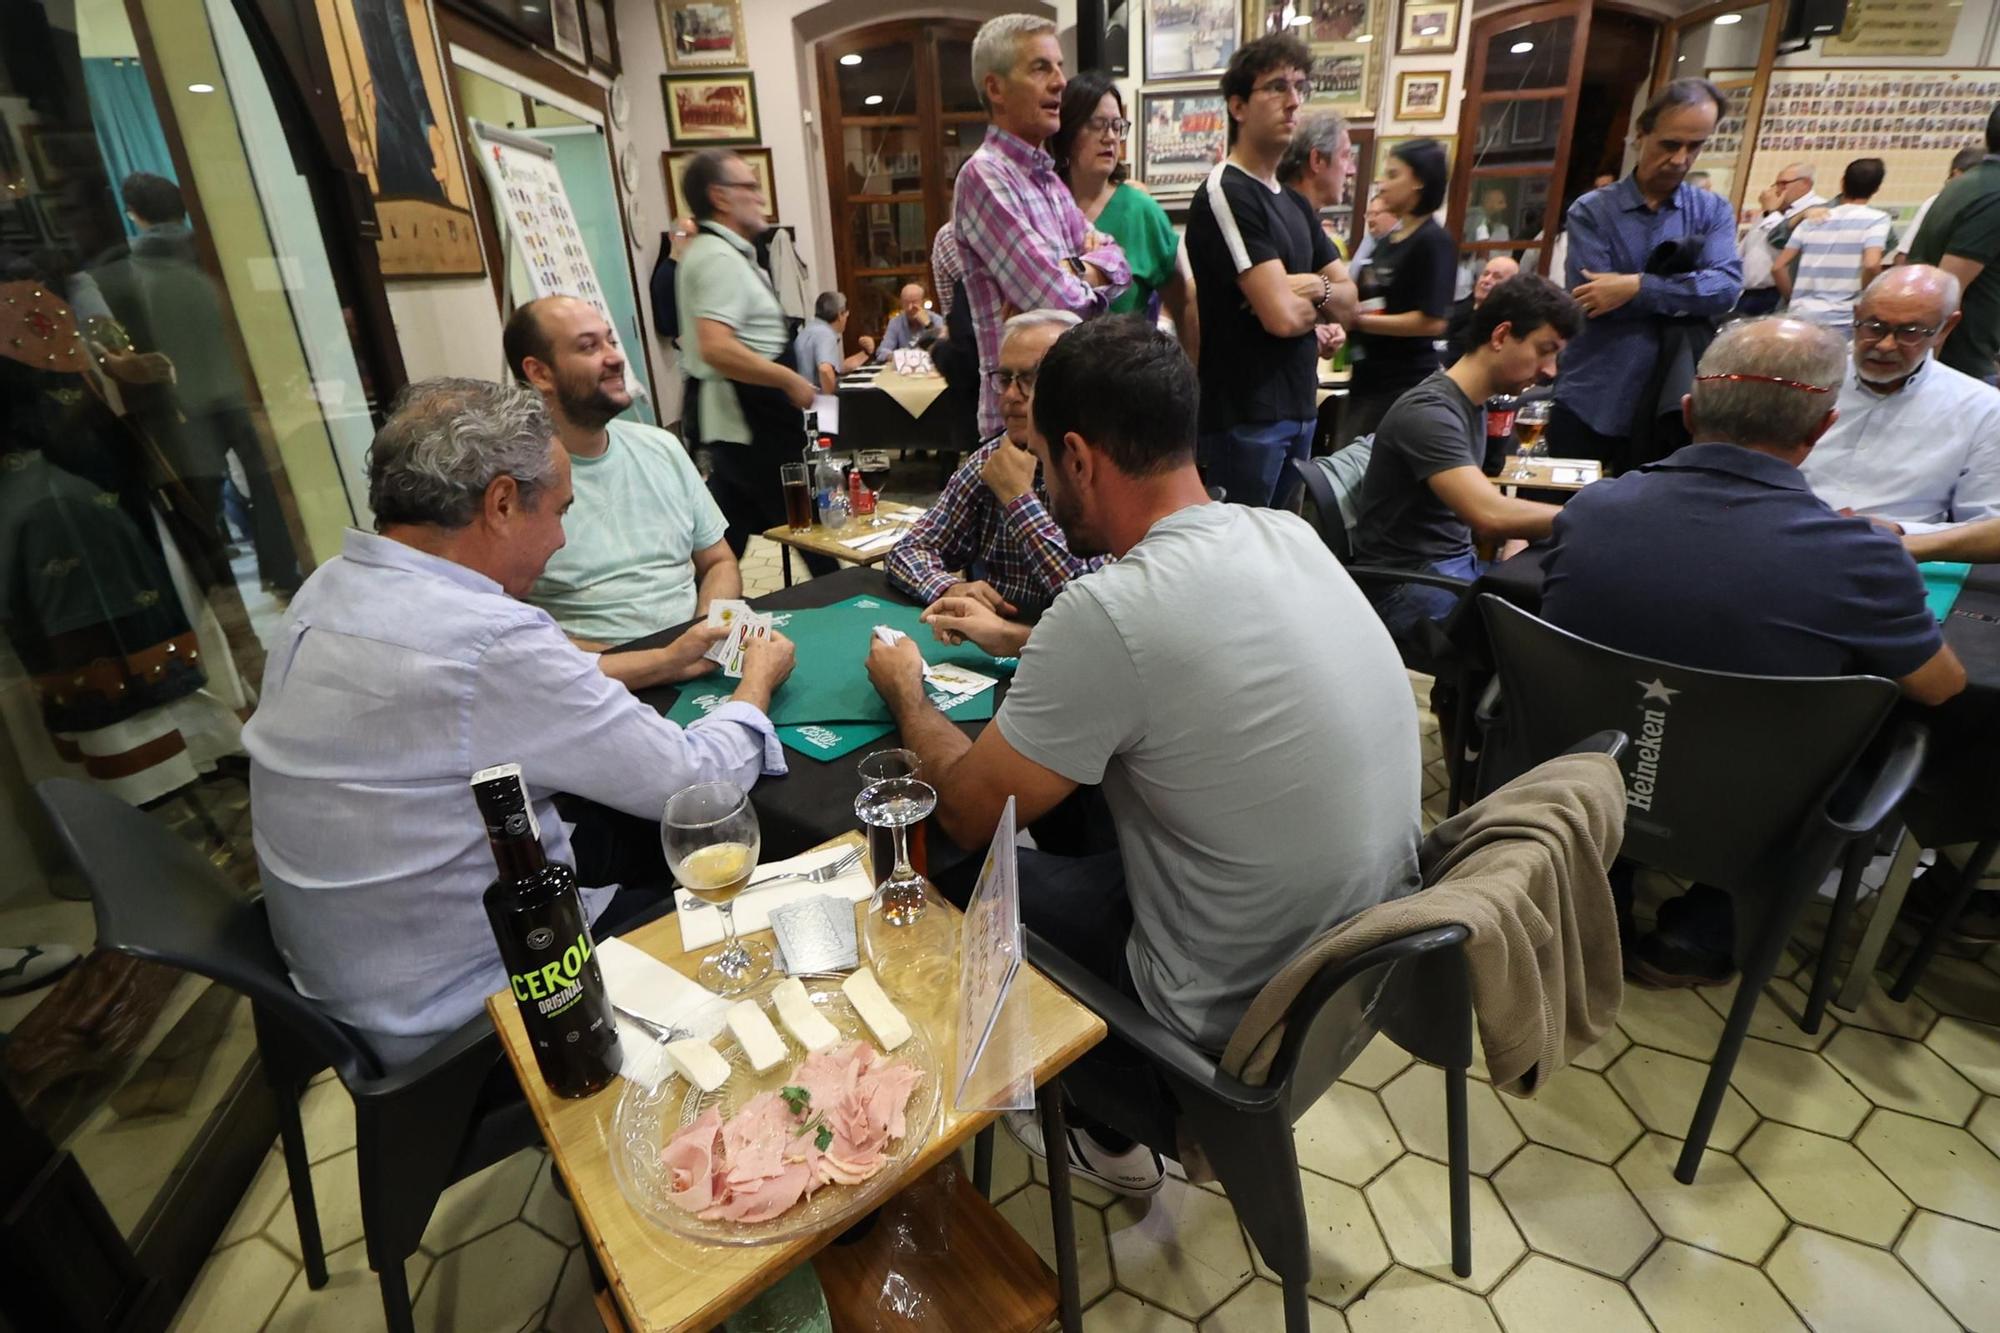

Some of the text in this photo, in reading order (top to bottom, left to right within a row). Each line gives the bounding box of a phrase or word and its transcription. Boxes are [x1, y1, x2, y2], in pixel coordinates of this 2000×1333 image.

[1626, 708, 1666, 812] Heineken
[511, 934, 592, 1001] CEROL
[538, 978, 585, 1015] ORIGINAL
